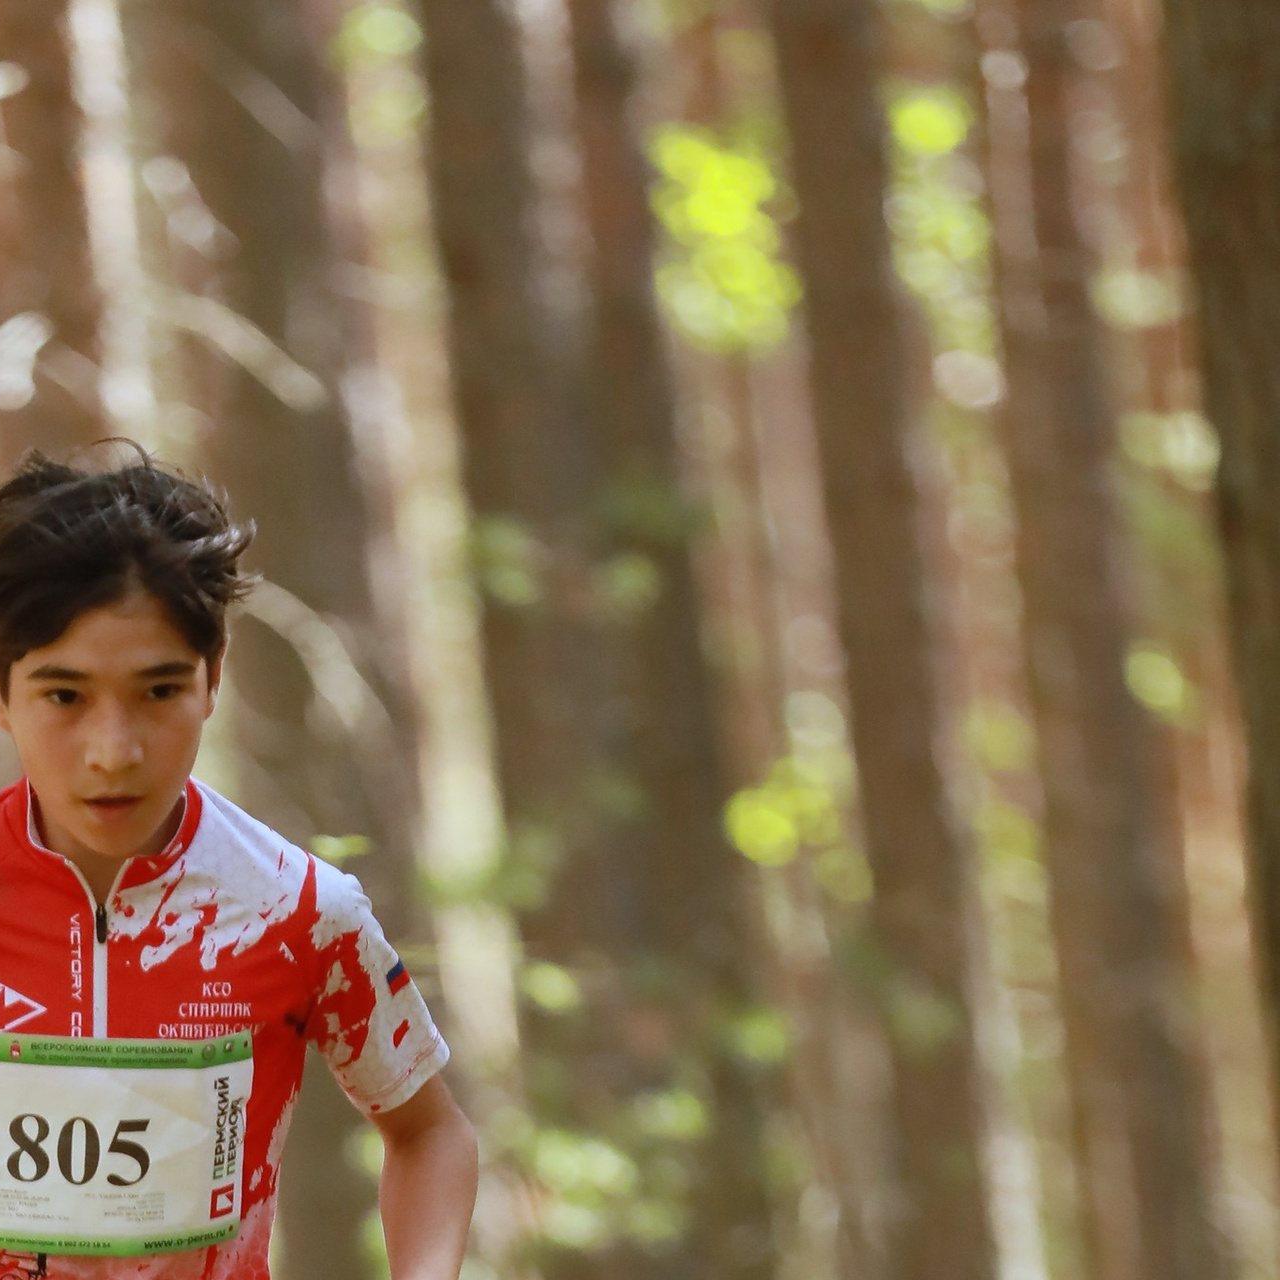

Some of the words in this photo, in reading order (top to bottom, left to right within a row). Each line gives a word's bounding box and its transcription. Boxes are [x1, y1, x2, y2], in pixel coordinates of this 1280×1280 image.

[70, 913, 82, 1001] VICTORY
[202, 982, 232, 997] КСО
[178, 1002, 252, 1017] СПАРТАК
[30, 1042, 113, 1053] ВСЕРОССИЙСКИЕ
[115, 1044, 193, 1054] СОРЕВНОВАНИЯ
[212, 1076, 229, 1180] ПЕРМСКИЙ
[6, 1113, 151, 1186] 805
[144, 1229, 226, 1249] www.o-perm.ru
